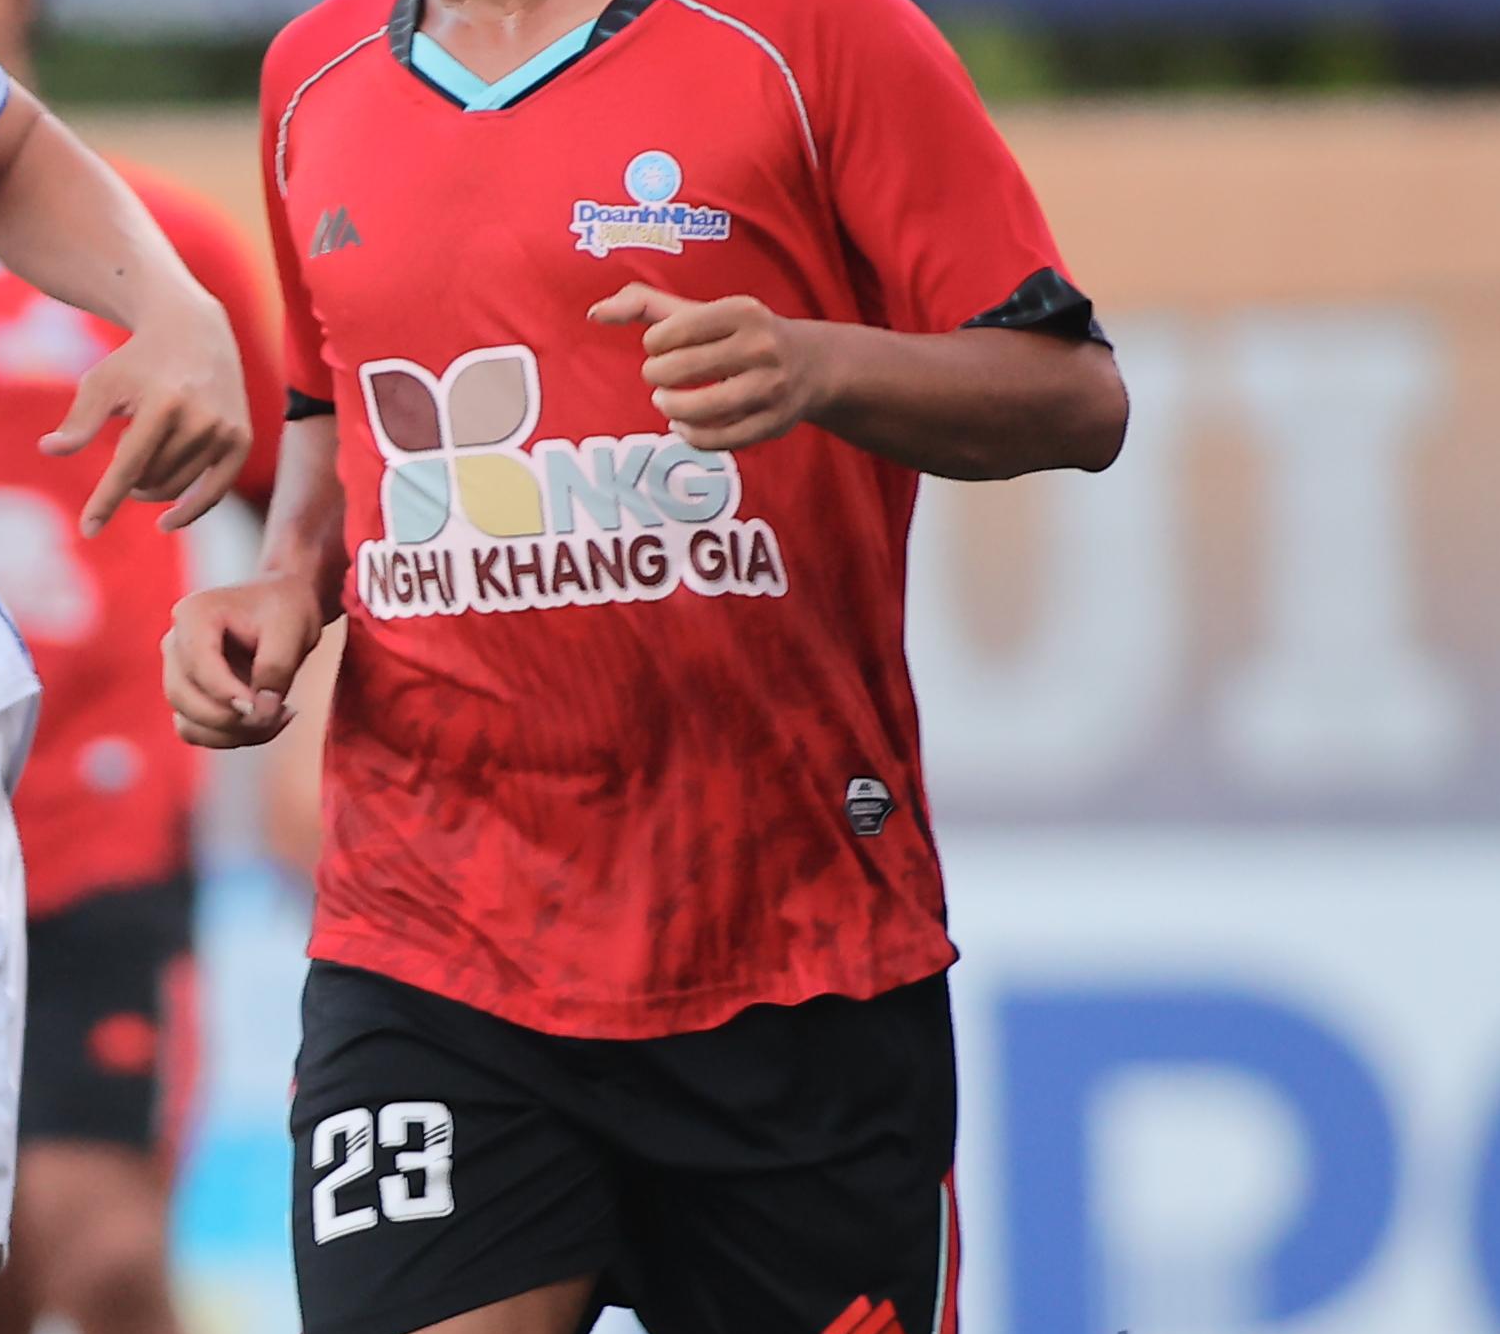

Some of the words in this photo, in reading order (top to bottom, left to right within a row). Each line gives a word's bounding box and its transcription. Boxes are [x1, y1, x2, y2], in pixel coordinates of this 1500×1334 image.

[545, 441, 731, 535] NKG
[472, 534, 669, 603] KHANG
[689, 528, 780, 587] GIA
[312, 1100, 455, 1246] 23
